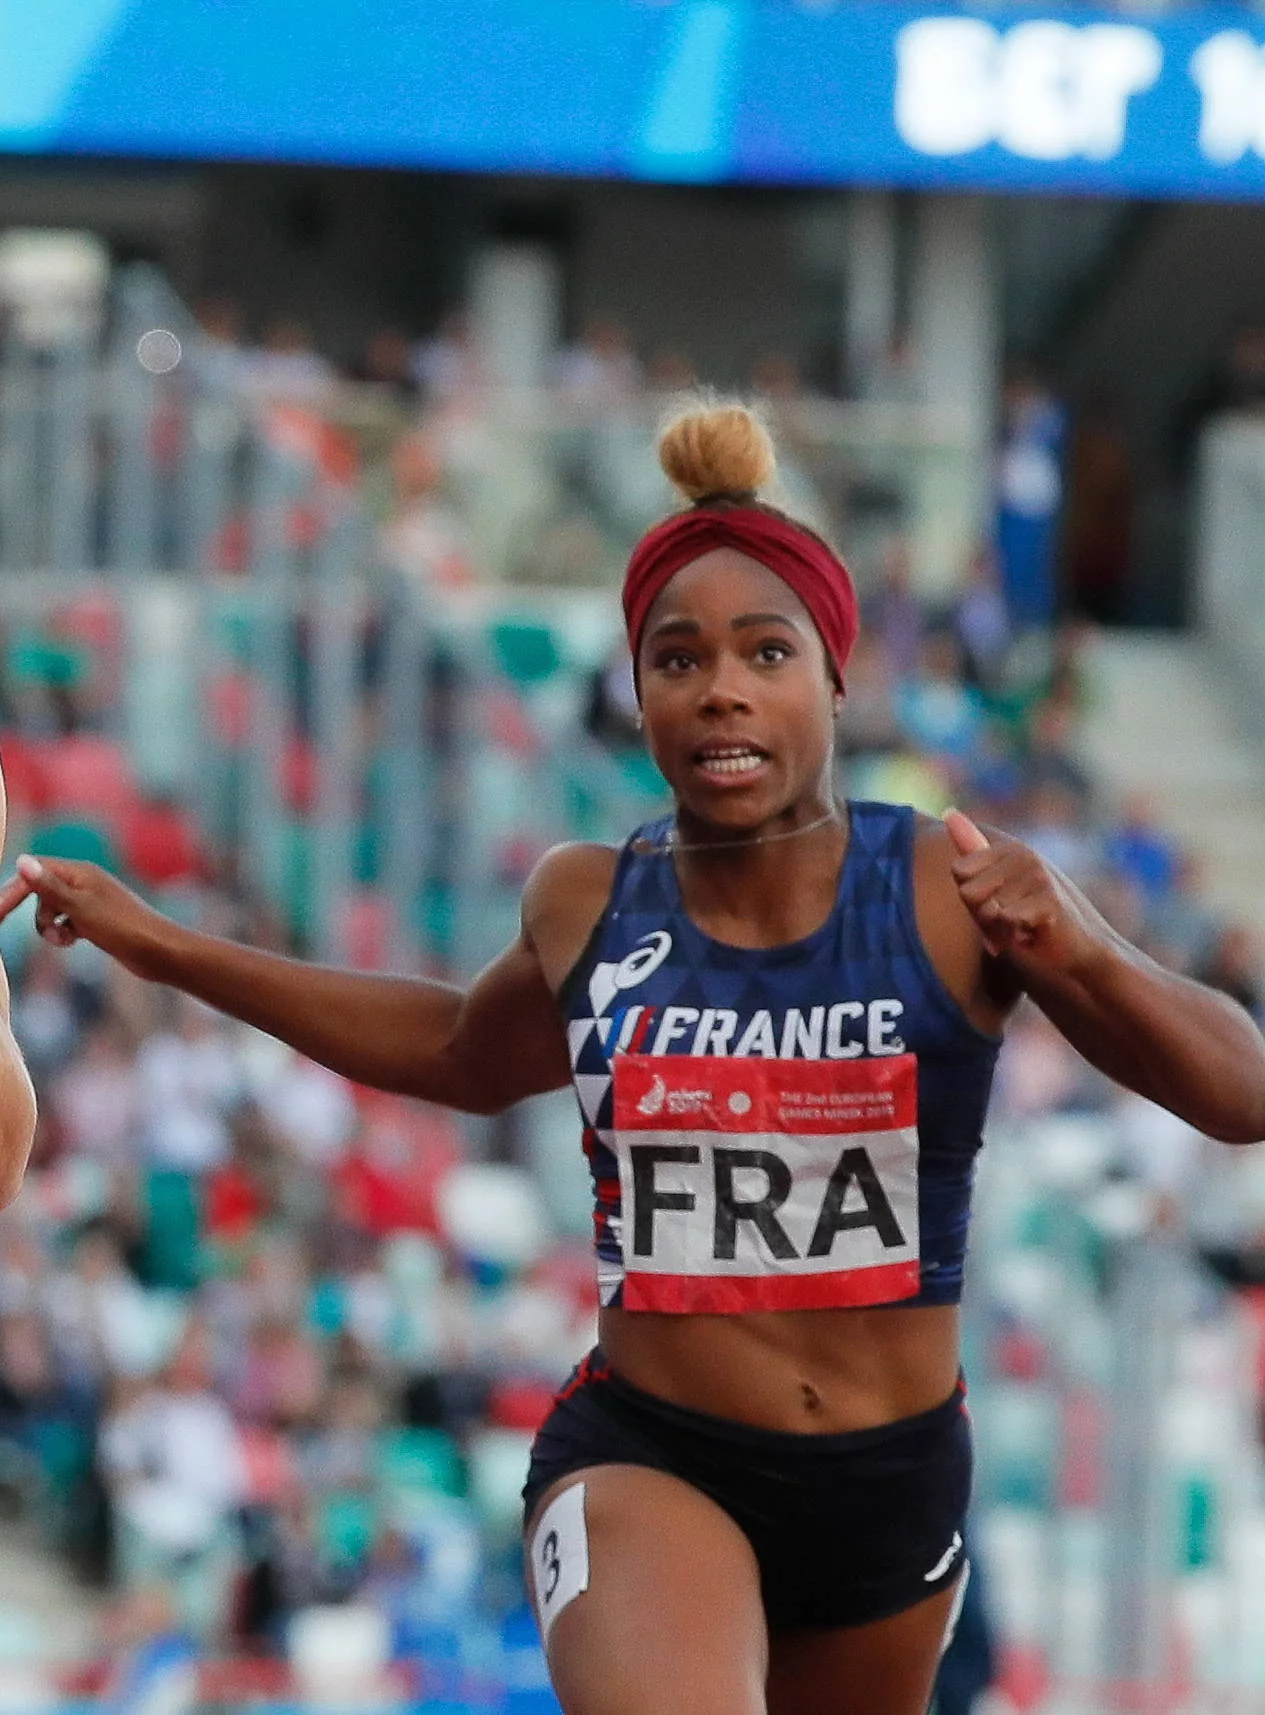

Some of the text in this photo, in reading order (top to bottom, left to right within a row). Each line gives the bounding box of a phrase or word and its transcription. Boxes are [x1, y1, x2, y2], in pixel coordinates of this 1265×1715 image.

[650, 999, 906, 1059] FRANCE
[630, 1146, 907, 1259] FRA
[543, 1530, 560, 1604] 3
